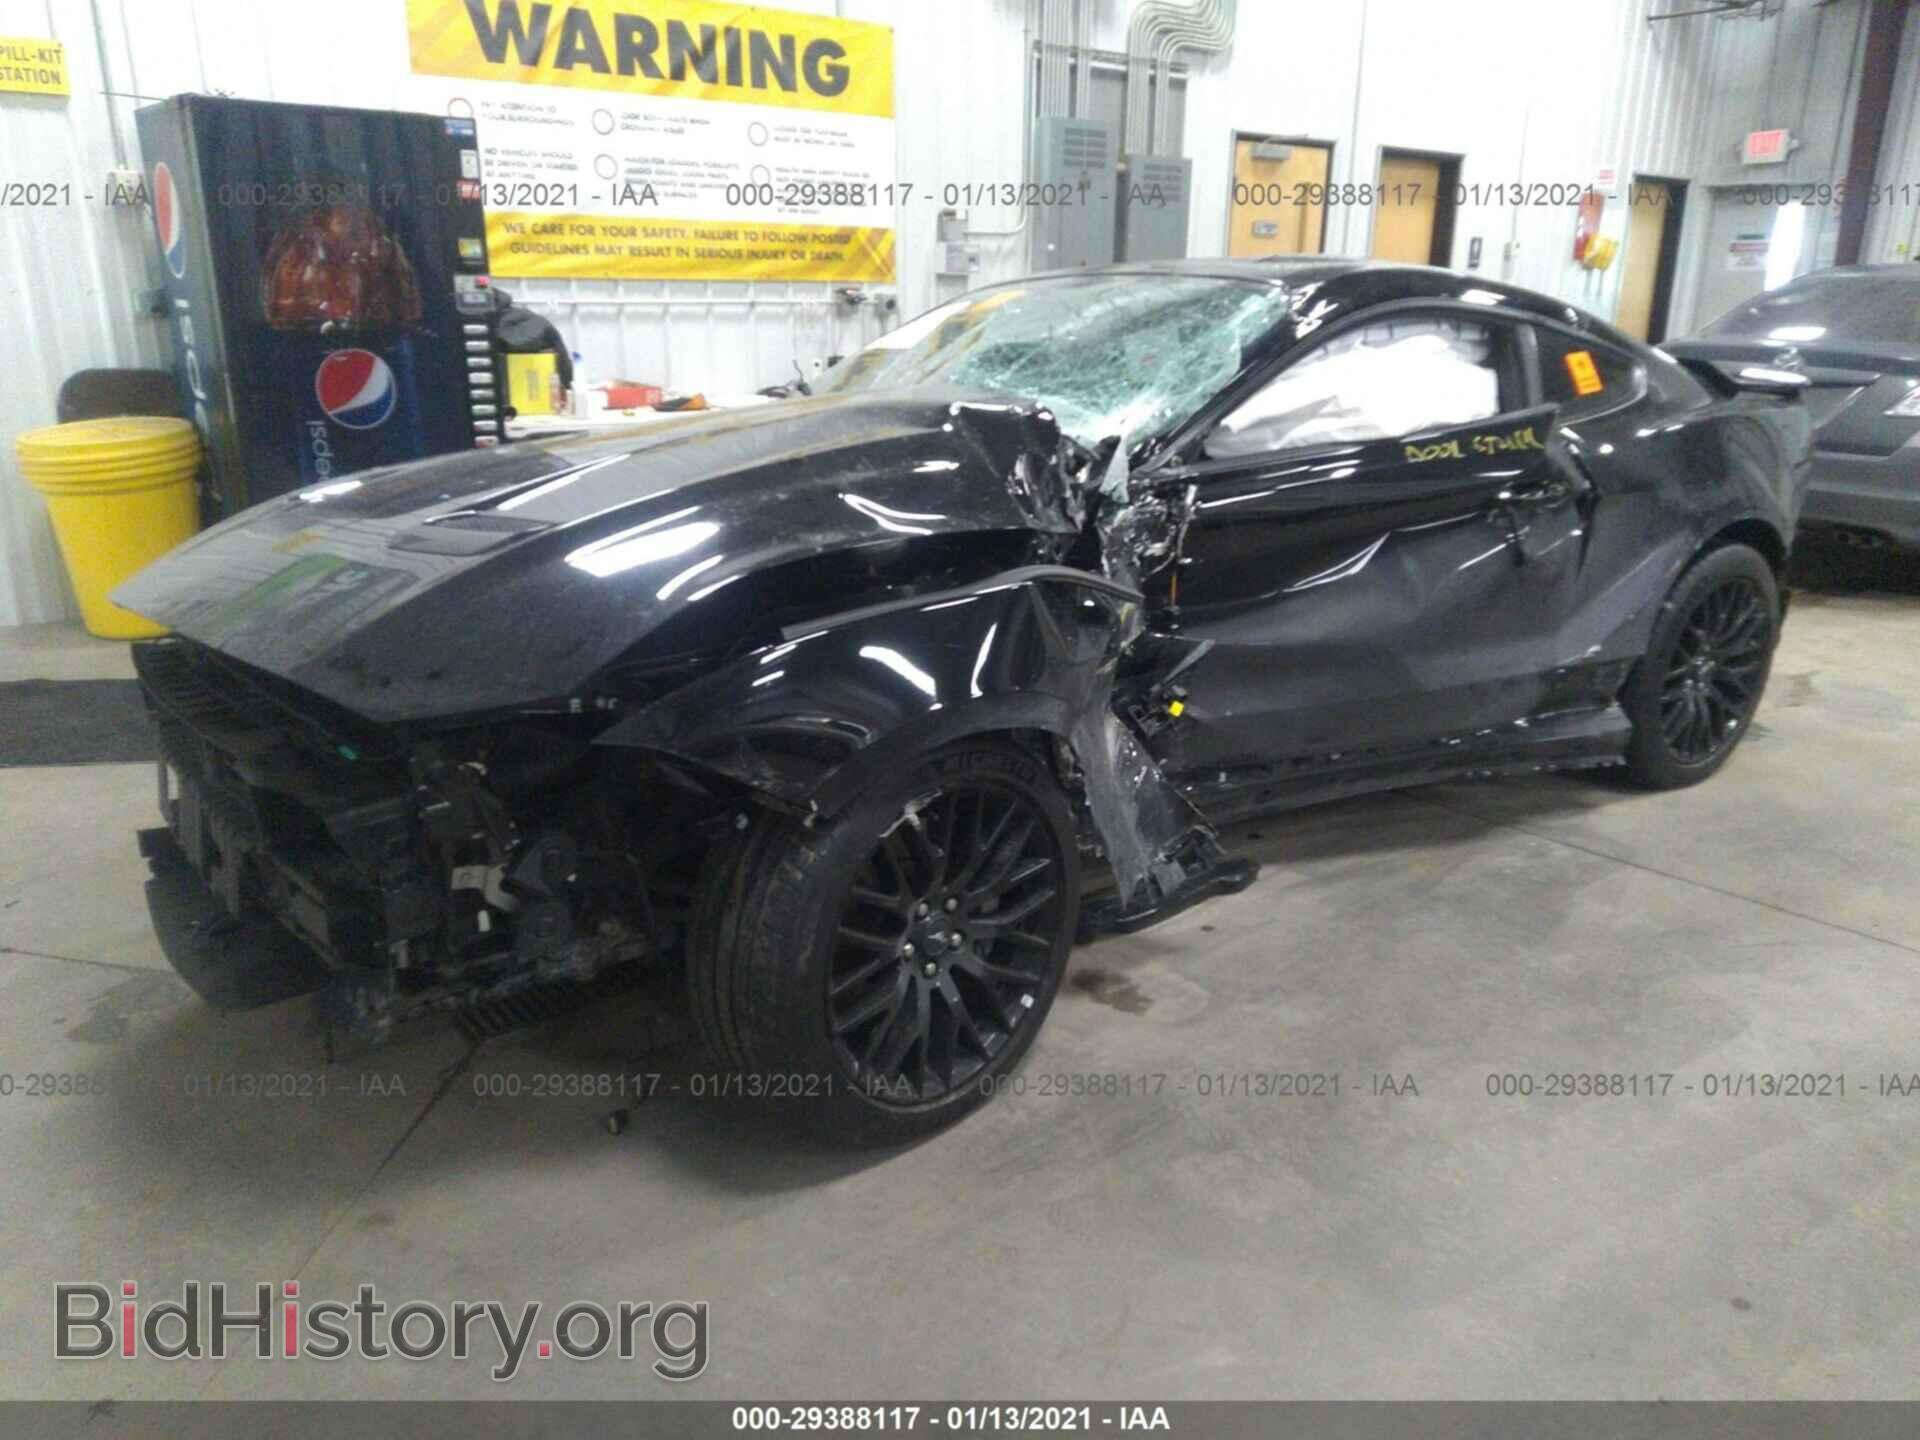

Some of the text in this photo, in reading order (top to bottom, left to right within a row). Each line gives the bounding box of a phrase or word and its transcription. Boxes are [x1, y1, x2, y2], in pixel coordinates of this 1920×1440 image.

[463, 0, 850, 97] WARNING
[503, 223, 526, 234] WE
[531, 223, 563, 236] CARE
[569, 224, 595, 236] FOR
[601, 225, 637, 238] YOUR
[694, 229, 738, 241] FAILURE
[744, 230, 758, 241] TO
[762, 231, 807, 243] FOLLOW
[511, 242, 589, 255] GUIDELINES
[595, 245, 623, 256] MAY
[629, 246, 671, 258] RESULT
[676, 247, 689, 257] IN
[694, 247, 742, 259] SERIOUS
[790, 250, 804, 260] OR
